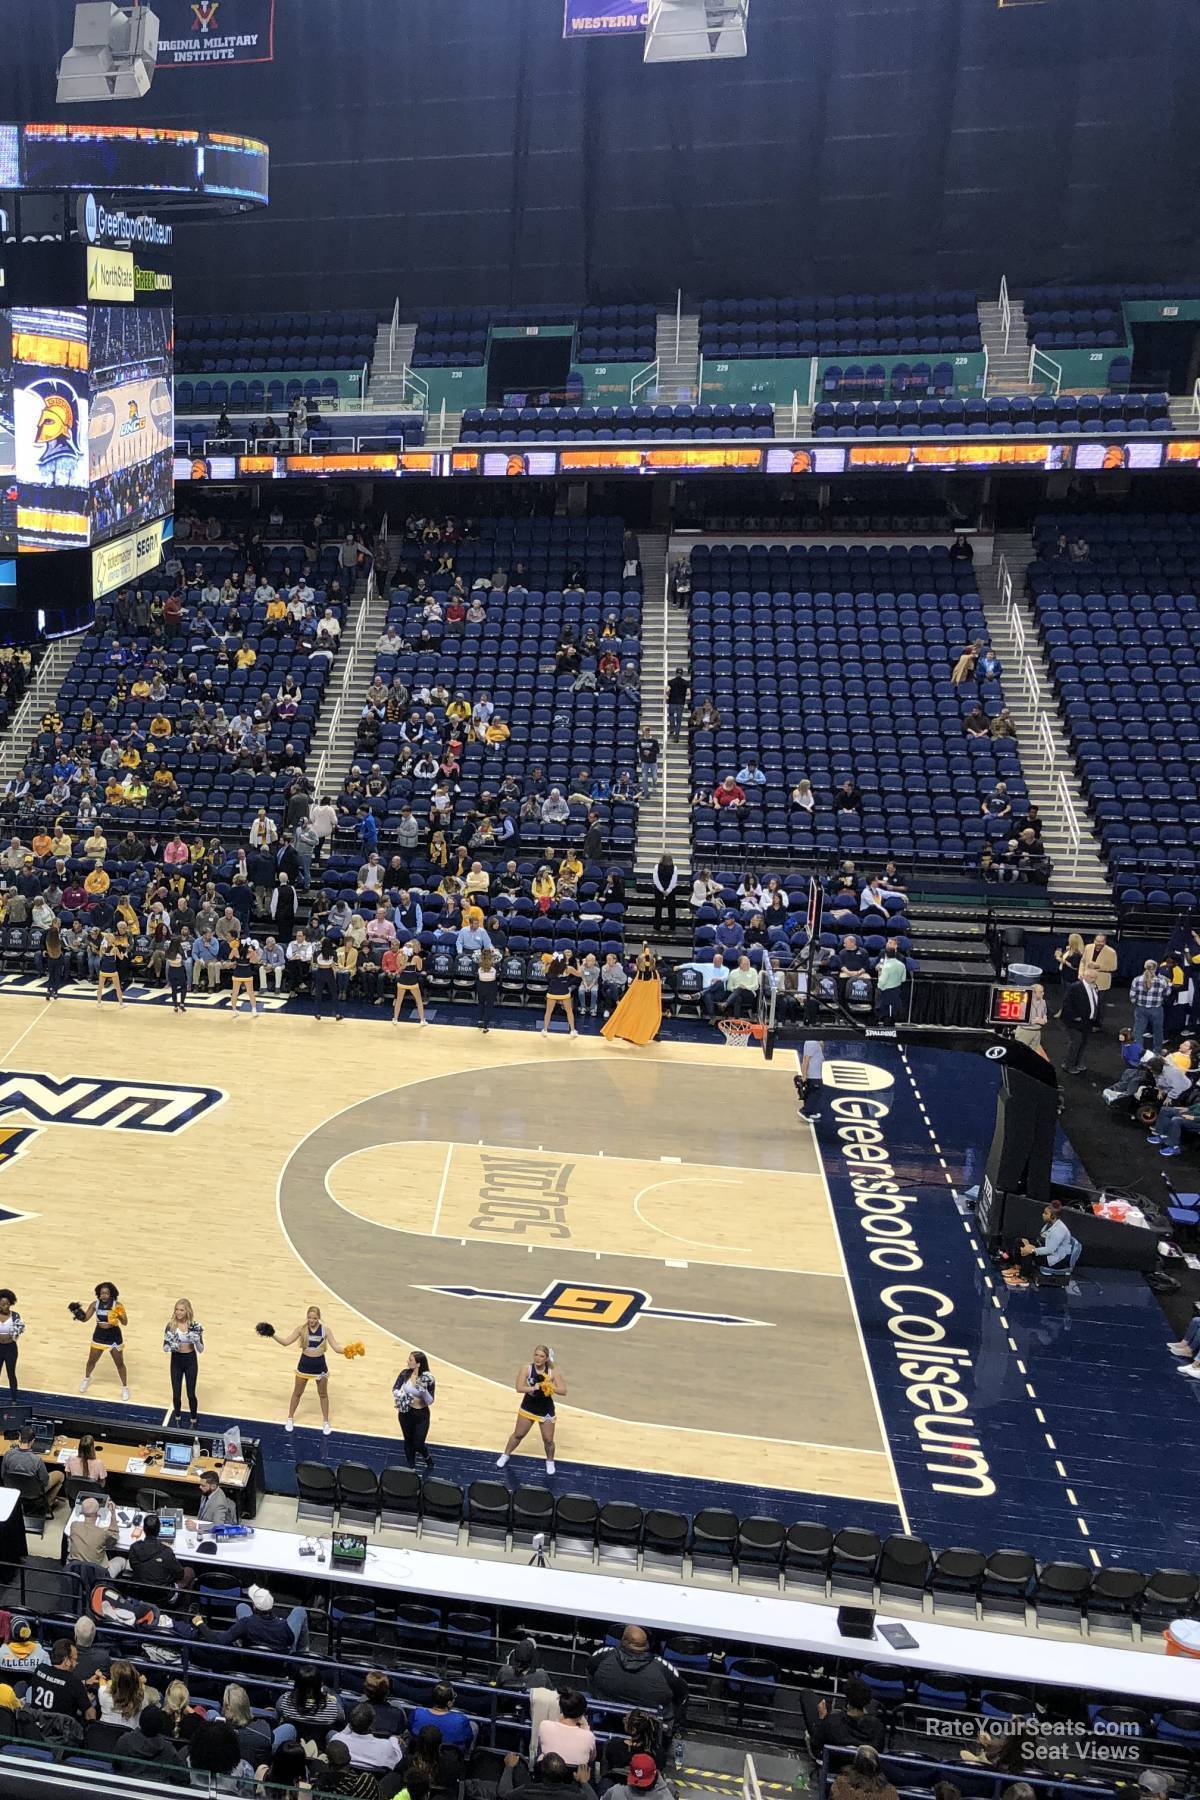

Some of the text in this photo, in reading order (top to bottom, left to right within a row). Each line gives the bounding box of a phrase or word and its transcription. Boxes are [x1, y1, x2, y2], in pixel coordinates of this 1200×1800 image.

[571, 15, 638, 30] WESTERN
[157, 34, 259, 52] IRGINIA MILITARY
[174, 48, 235, 63] INSTITUTE
[98, 204, 173, 246] Greensboro Coliseum
[100, 263, 133, 288] NorthState
[716, 364, 730, 373] 229
[955, 357, 969, 366] 229
[348, 374, 360, 382] 231
[451, 371, 463, 379] 230
[120, 417, 147, 438] UNCG
[1002, 991, 1029, 1004] 5:51
[999, 1002, 1022, 1018] 30
[865, 1029, 897, 1038] SPALDING
[468, 1153, 577, 1239] SOCON
[830, 1096, 997, 1497] Greensboro Coliseum
[34, 1686, 55, 1709] 20
